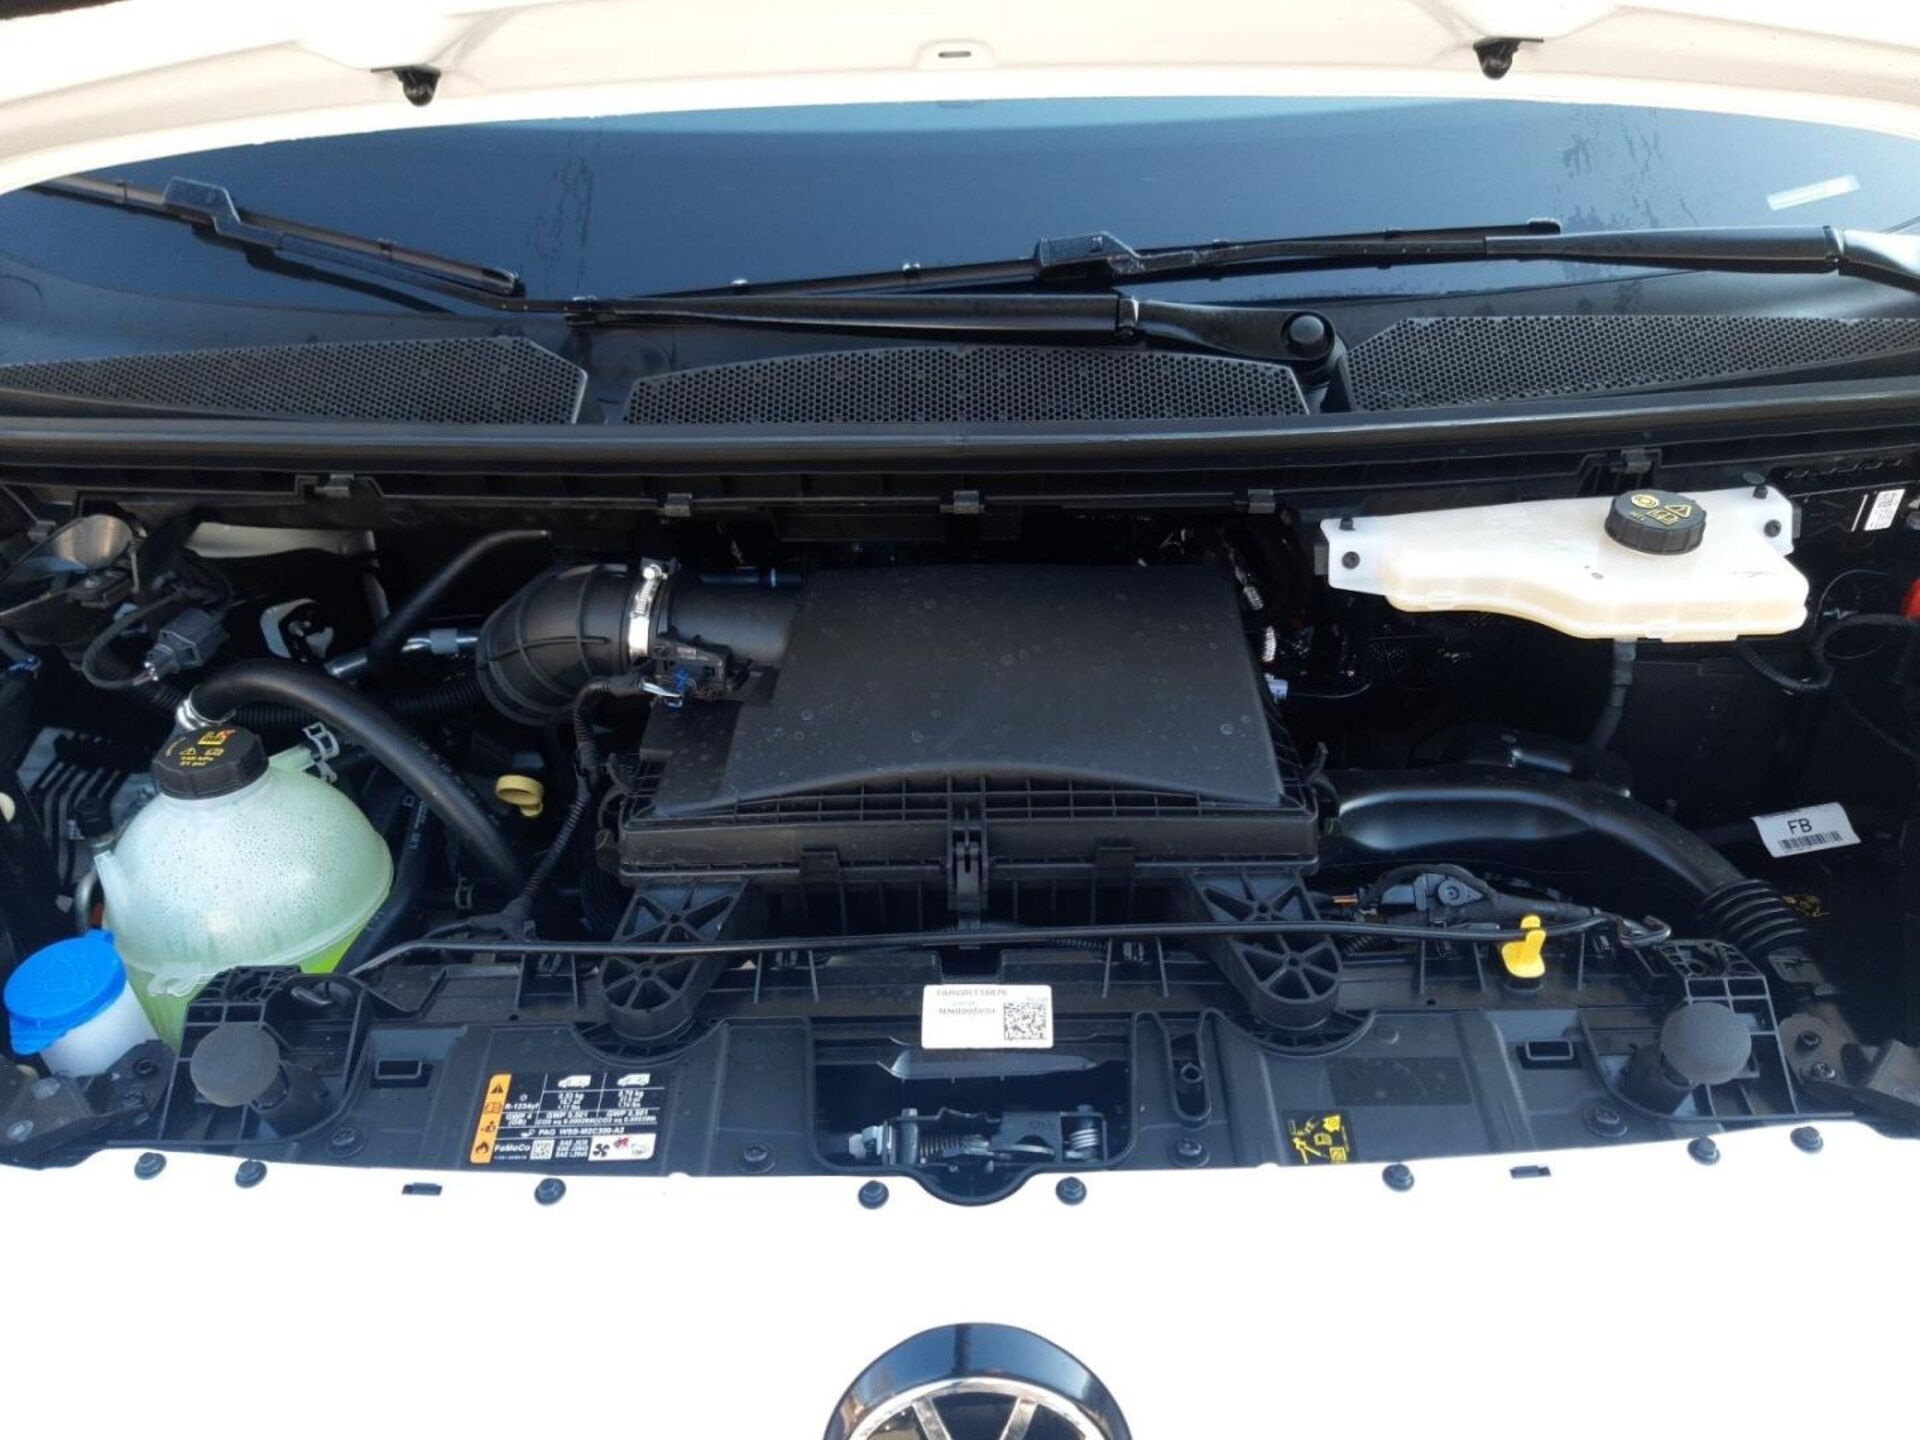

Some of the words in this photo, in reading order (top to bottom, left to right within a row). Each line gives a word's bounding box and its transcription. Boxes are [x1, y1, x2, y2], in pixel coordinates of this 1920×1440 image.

[1787, 817, 1813, 835] FB
[546, 1111, 566, 1119] GWP
[606, 1109, 627, 1117] GWP
[494, 1144, 531, 1153] FoMoCo
